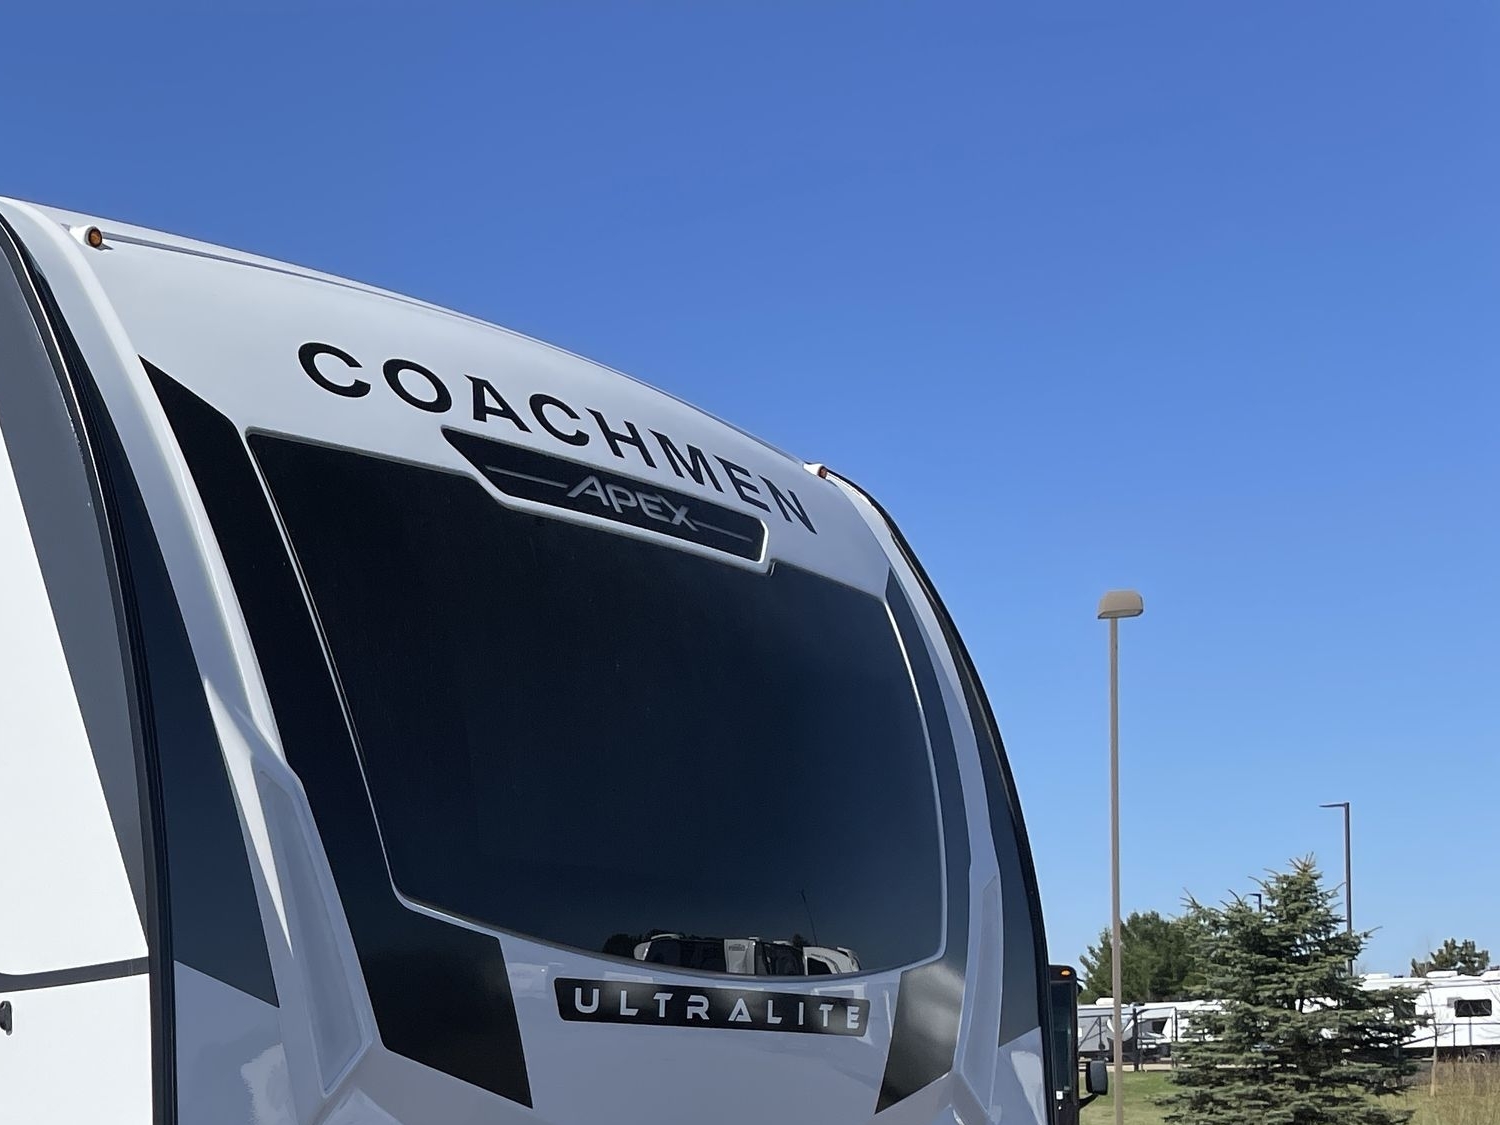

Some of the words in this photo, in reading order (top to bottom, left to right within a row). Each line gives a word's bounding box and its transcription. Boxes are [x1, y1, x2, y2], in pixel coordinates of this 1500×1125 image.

[297, 341, 817, 534] COACHMEN
[566, 475, 699, 532] APEX
[574, 986, 861, 1030] ULTRALITE
